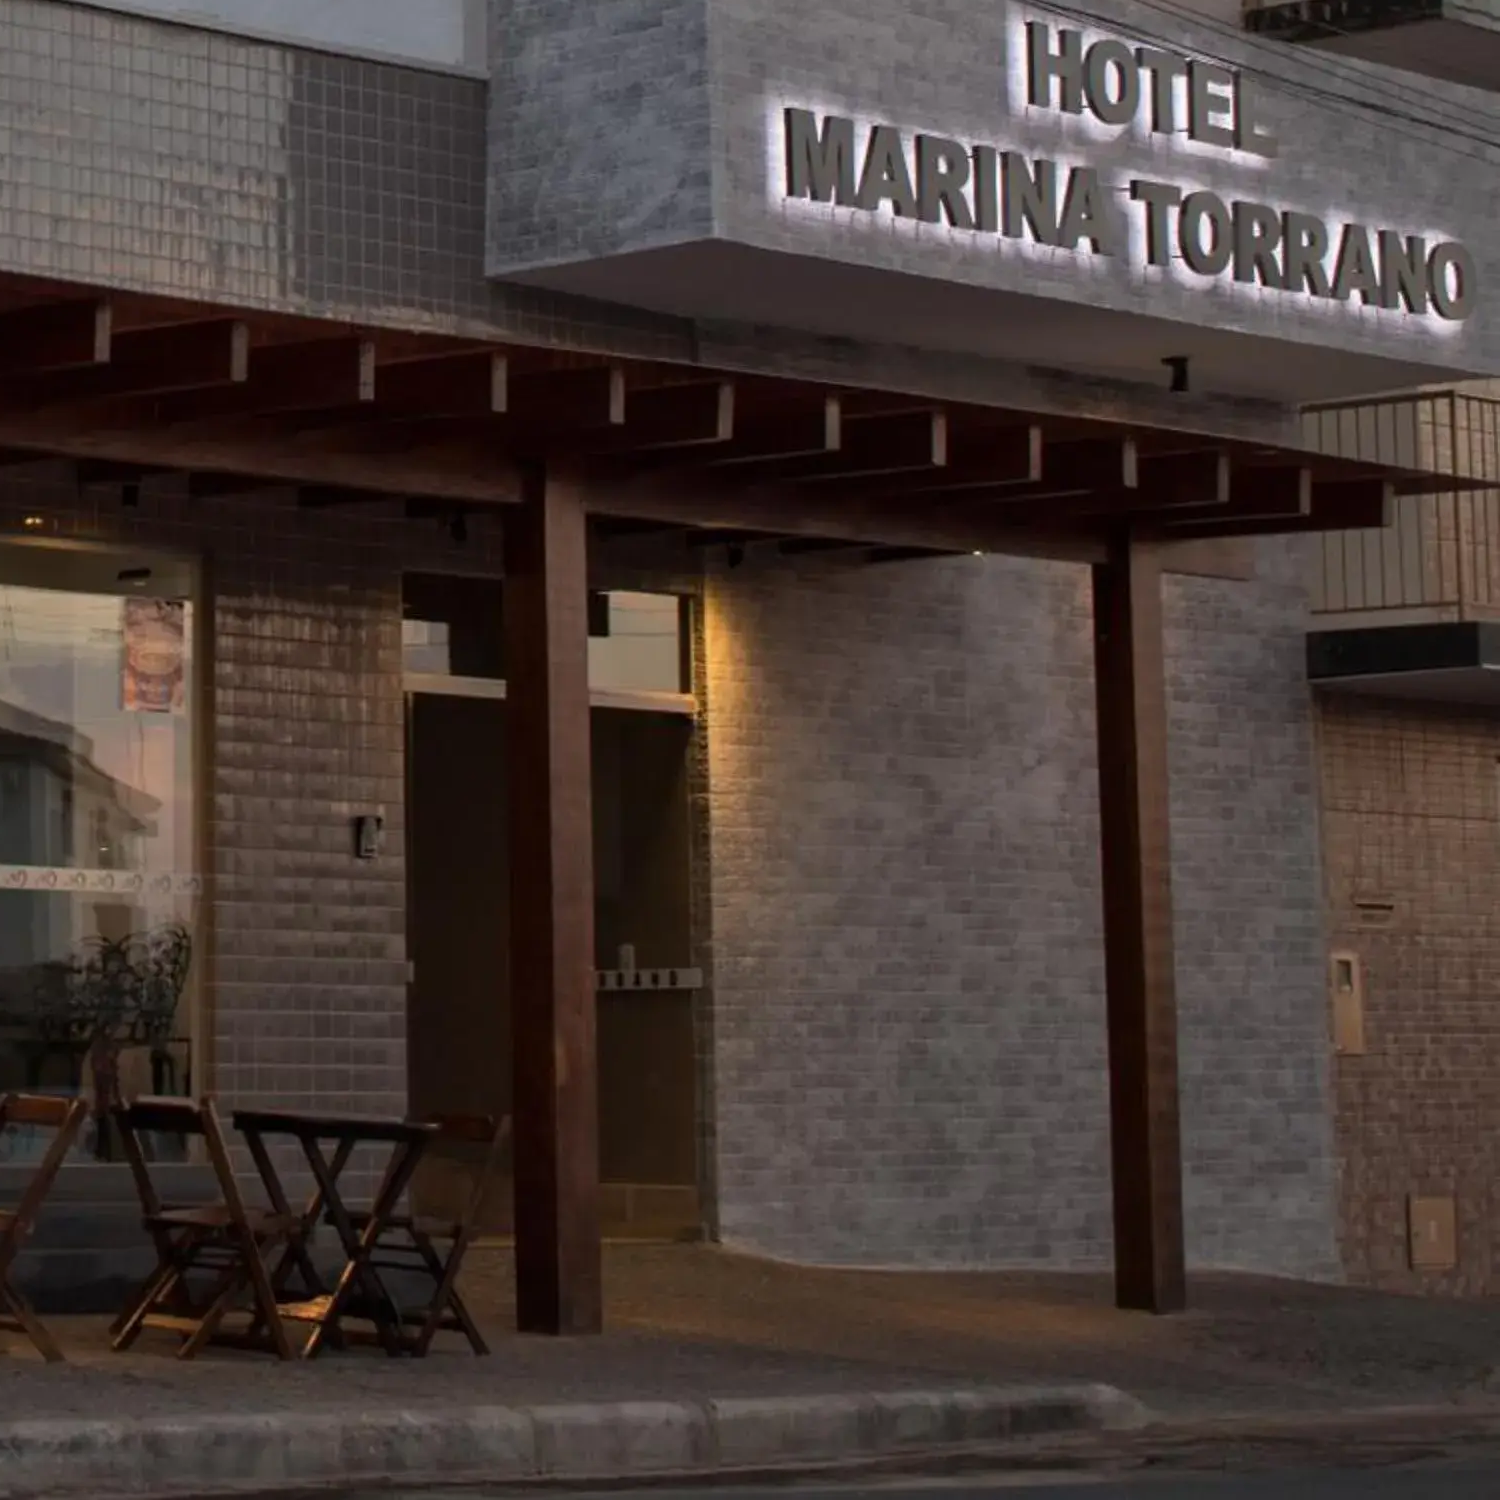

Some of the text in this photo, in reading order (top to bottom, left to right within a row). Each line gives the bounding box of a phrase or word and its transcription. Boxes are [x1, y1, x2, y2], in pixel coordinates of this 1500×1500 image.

[1025, 20, 1278, 159] HOTEL
[783, 106, 1477, 321] MARINA TORRANO
